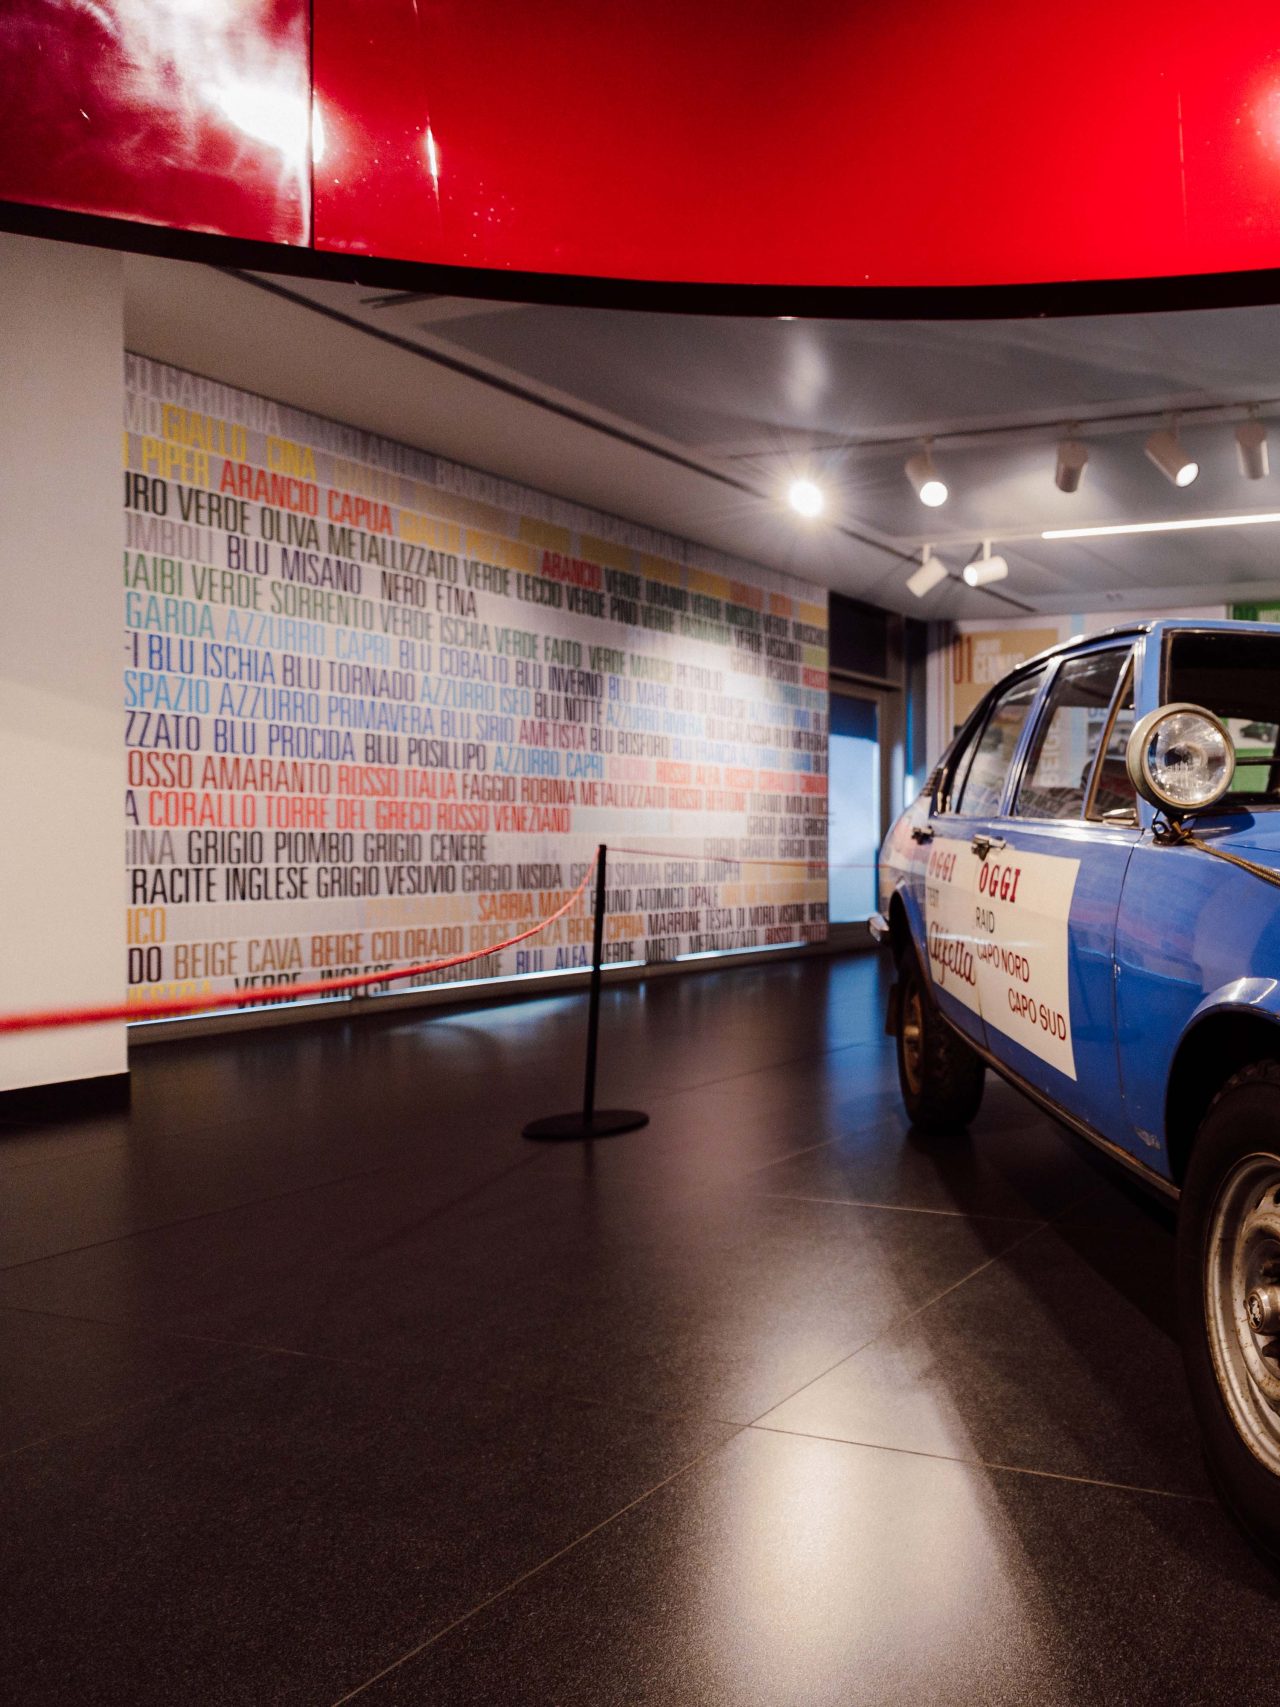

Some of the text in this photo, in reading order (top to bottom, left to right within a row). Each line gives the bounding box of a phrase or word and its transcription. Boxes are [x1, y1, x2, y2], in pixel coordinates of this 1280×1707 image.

[160, 402, 246, 461] GIALLO
[142, 436, 208, 488] PIPER
[218, 457, 318, 516] ARANCIO
[326, 487, 392, 535] CAPUA
[176, 484, 250, 535] VERDE
[260, 505, 320, 551] OLIVA
[326, 522, 458, 583] METALLIZZATO
[462, 557, 510, 595] VERDE
[516, 570, 562, 607] LECCIO
[566, 583, 604, 617] VERDE
[226, 534, 268, 575] BLU
[280, 546, 362, 594] MISANO
[380, 568, 426, 608] NERO
[436, 581, 478, 618] ETNA
[122, 550, 182, 596] AIBI
[190, 563, 262, 610] VERDE
[270, 579, 374, 630] SORRENTO
[380, 602, 432, 641] VERDE
[440, 614, 490, 651] ISCHIA
[494, 625, 538, 659] VERDE
[544, 635, 582, 667] FAITO
[588, 644, 626, 675] VERDE
[124, 590, 216, 639] GARDA
[224, 607, 326, 656] AZZURRO
[334, 627, 390, 666] CAPRI
[398, 638, 430, 672] BLU
[438, 645, 508, 684] COBALTO
[514, 658, 542, 689] BLU
[548, 664, 604, 698] INVERNO
[608, 675, 632, 702] BLU
[146, 633, 194, 674] BLU
[202, 641, 276, 684] ISCHIA
[280, 653, 320, 690] BLU
[328, 660, 416, 702] TORNADO
[420, 674, 496, 712] AZZURRO
[498, 685, 530, 716] ISEO
[534, 691, 560, 720] BLU
[562, 695, 604, 725] NOTTE
[122, 669, 210, 714] SPAZIO
[218, 681, 320, 725] AZZURRO
[326, 694, 434, 736] PRIMAVERA
[438, 708, 470, 739] BLU
[474, 712, 514, 744] SIRIO
[518, 718, 586, 751] AMETISTA
[588, 726, 614, 753] BLU
[616, 730, 668, 758] BOSFORO
[124, 709, 200, 750] ZZATO
[212, 718, 256, 755] BLU
[268, 723, 356, 762] PROCIDA
[364, 732, 398, 765] BLU
[406, 737, 486, 771] POSILLIPO
[492, 745, 558, 776] AZZURRO
[564, 752, 604, 779] CAPRI
[200, 754, 330, 795] AMARANTO
[336, 764, 398, 798] ROSSO
[402, 769, 458, 800] ITALIA
[460, 773, 516, 803] FAGGIO
[520, 777, 576, 805] ROBINIA
[580, 781, 666, 809] METALLIZZATO
[148, 789, 256, 827] CORALLO
[264, 795, 330, 829] TORRE
[334, 798, 366, 830] DEL
[374, 800, 432, 831] GRECO
[436, 803, 490, 832] ROSSO
[492, 805, 572, 833] VENEZIANO
[186, 829, 264, 864] GRIGIO
[274, 831, 354, 864] PIOMBO
[362, 833, 422, 863] GRIGIO
[430, 834, 488, 863] CENERE
[929, 850, 957, 883] OGGI
[126, 867, 216, 904] RACITE
[224, 867, 308, 901] INGLESE
[316, 866, 380, 898] GRIGIO
[384, 866, 456, 896] VESUVIO
[460, 865, 512, 893] GRIGIO
[516, 864, 562, 891] NISIDA
[478, 894, 534, 923] SABBIA
[634, 887, 684, 913] ATOMICO
[686, 885, 720, 909] OPALE
[978, 861, 1021, 903] OGGI
[126, 945, 162, 983] DO
[172, 941, 238, 979] BEIGE
[246, 937, 304, 974] CAVA
[310, 934, 364, 968] BEIGE
[370, 927, 464, 963] COLORADO
[606, 915, 644, 942] CIPRIA
[646, 911, 702, 938] MARRONE
[704, 908, 734, 932] TESTA
[734, 907, 744, 929] DI
[976, 906, 995, 934] RAID
[976, 943, 1030, 984] CAPO NORD
[1008, 987, 1067, 1041] CAPO SUD
